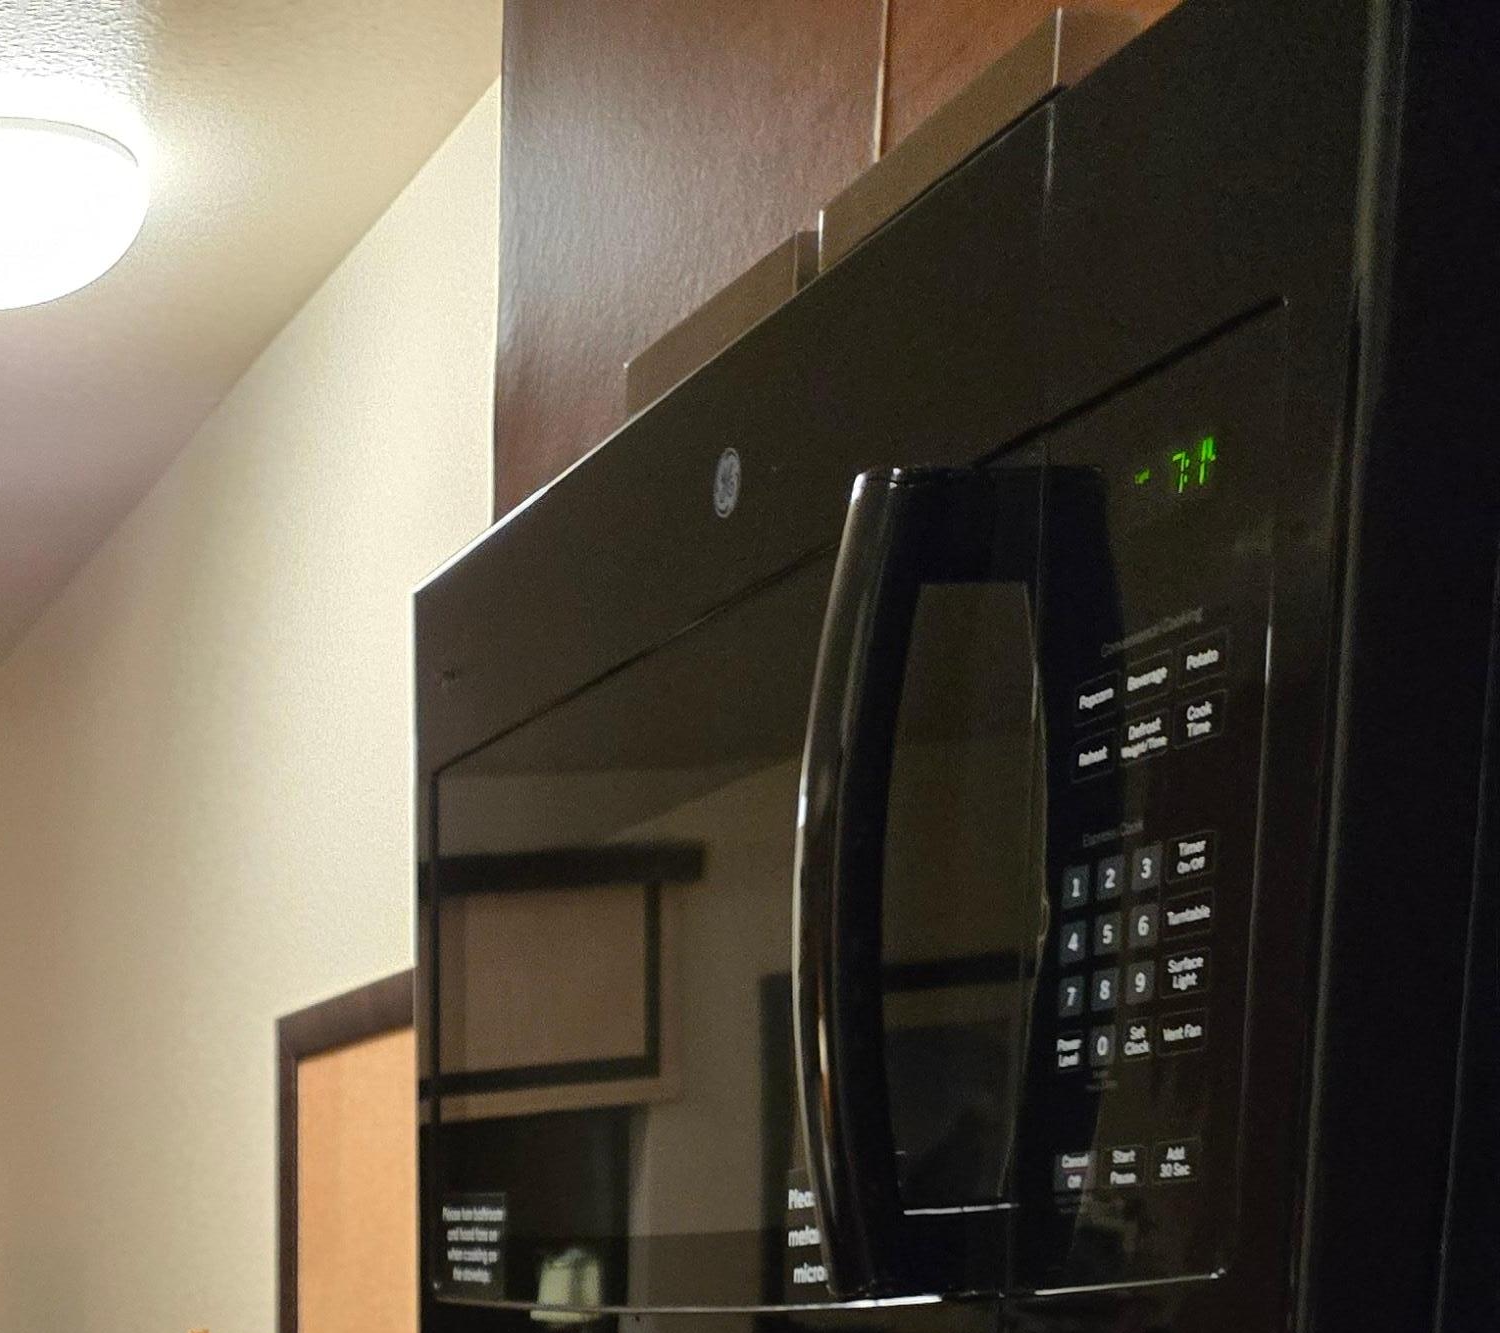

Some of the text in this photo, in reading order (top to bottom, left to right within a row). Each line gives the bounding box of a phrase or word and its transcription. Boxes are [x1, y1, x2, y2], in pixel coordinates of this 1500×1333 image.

[1186, 649, 1219, 670] Potato
[1079, 687, 1114, 709] Popcorn
[1186, 701, 1212, 721] Cook
[1128, 717, 1162, 741] Defrost
[1178, 840, 1206, 856] Timer
[1104, 867, 1116, 889] 2
[1140, 857, 1152, 879] 3
[1071, 878, 1080, 898] 1
[1102, 924, 1113, 945] 5
[1137, 915, 1150, 936] 6
[1067, 932, 1079, 952] 4
[1167, 956, 1204, 974] Surface
[1099, 979, 1111, 1000] 8
[1135, 972, 1146, 993] 9
[1172, 972, 1198, 991] Light
[1067, 986, 1077, 1007] 7
[1130, 1026, 1146, 1040] Set
[1163, 1023, 1202, 1041] Vent Fan
[1097, 1035, 1109, 1056] 0
[1124, 1039, 1150, 1056] Clock
[1112, 1150, 1136, 1164] Start
[1166, 1146, 1186, 1161] Add
[1159, 1162, 1191, 1178] 30 Sec
[788, 1188, 816, 1210] Plea
